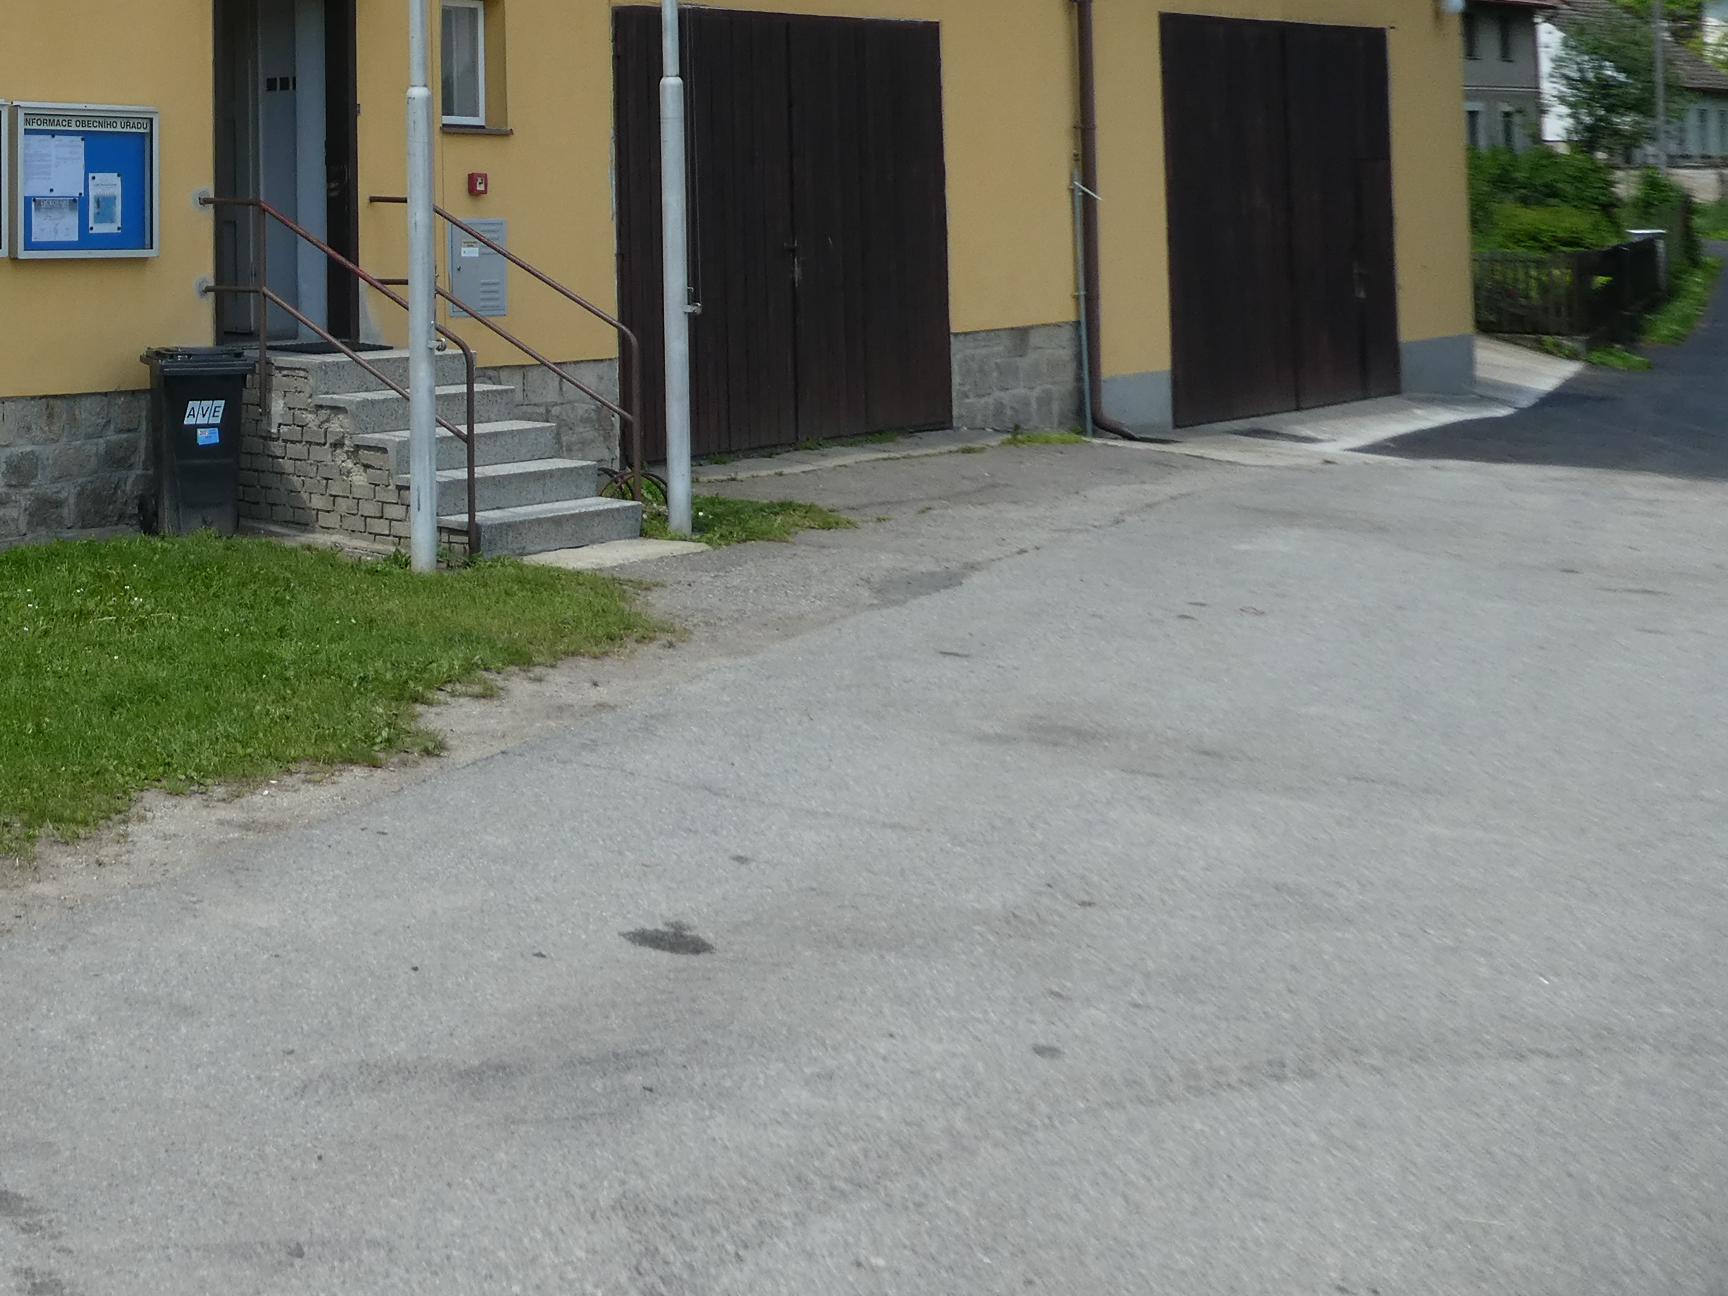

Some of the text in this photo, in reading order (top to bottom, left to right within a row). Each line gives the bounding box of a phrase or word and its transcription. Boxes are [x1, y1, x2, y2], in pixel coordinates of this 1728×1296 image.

[75, 118, 117, 129] OBECNÍHO
[120, 118, 148, 130] ÚŘADU
[187, 405, 222, 419] AVE
